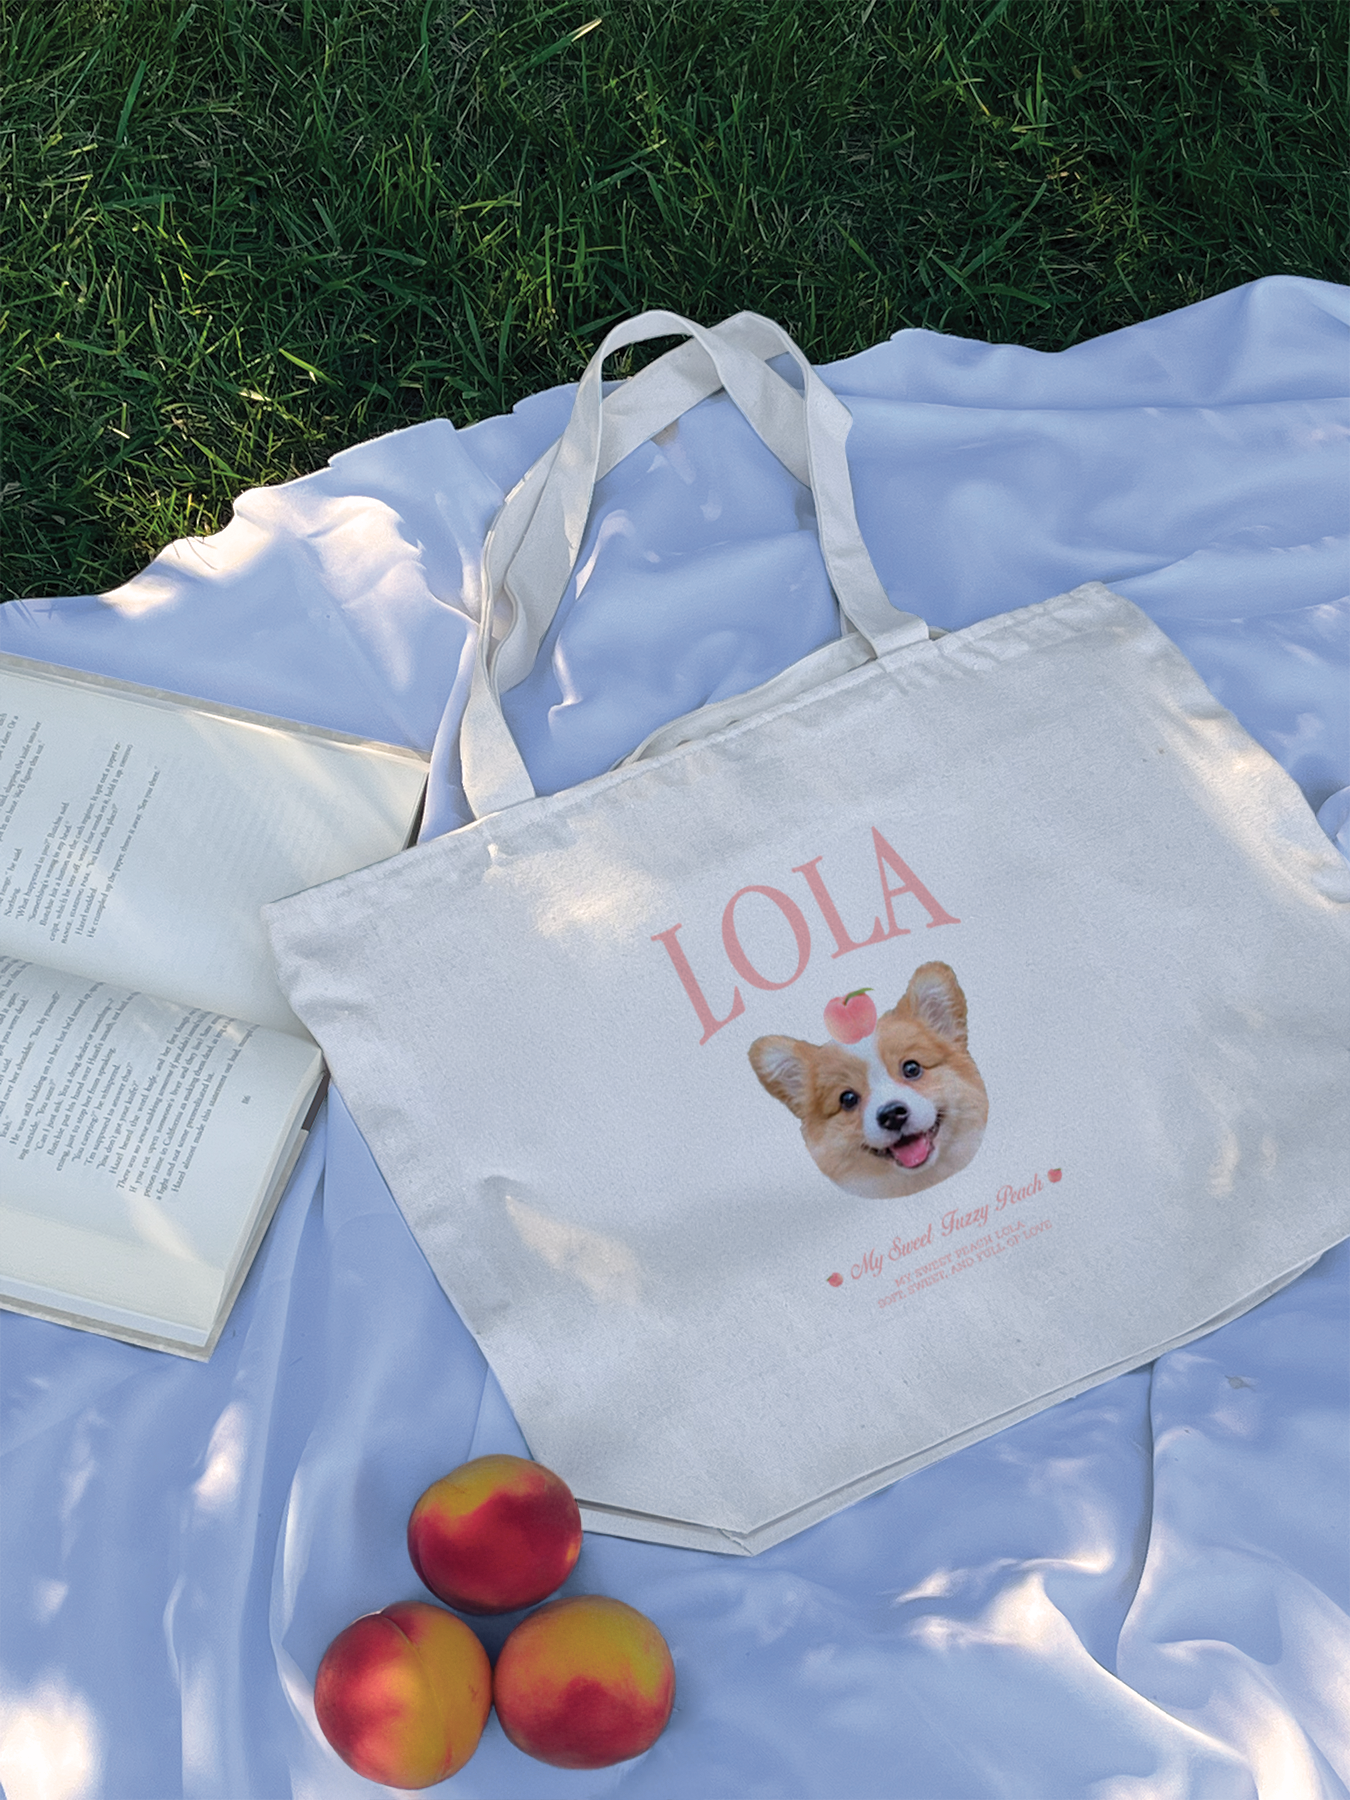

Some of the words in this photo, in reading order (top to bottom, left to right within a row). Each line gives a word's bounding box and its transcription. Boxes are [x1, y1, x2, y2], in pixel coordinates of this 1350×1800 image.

[650, 826, 960, 1046] LOLA
[850, 1247, 884, 1280] My
[887, 1222, 932, 1261] Sweet
[940, 1203, 989, 1237] Fuzzy
[994, 1172, 1044, 1212] Peach
